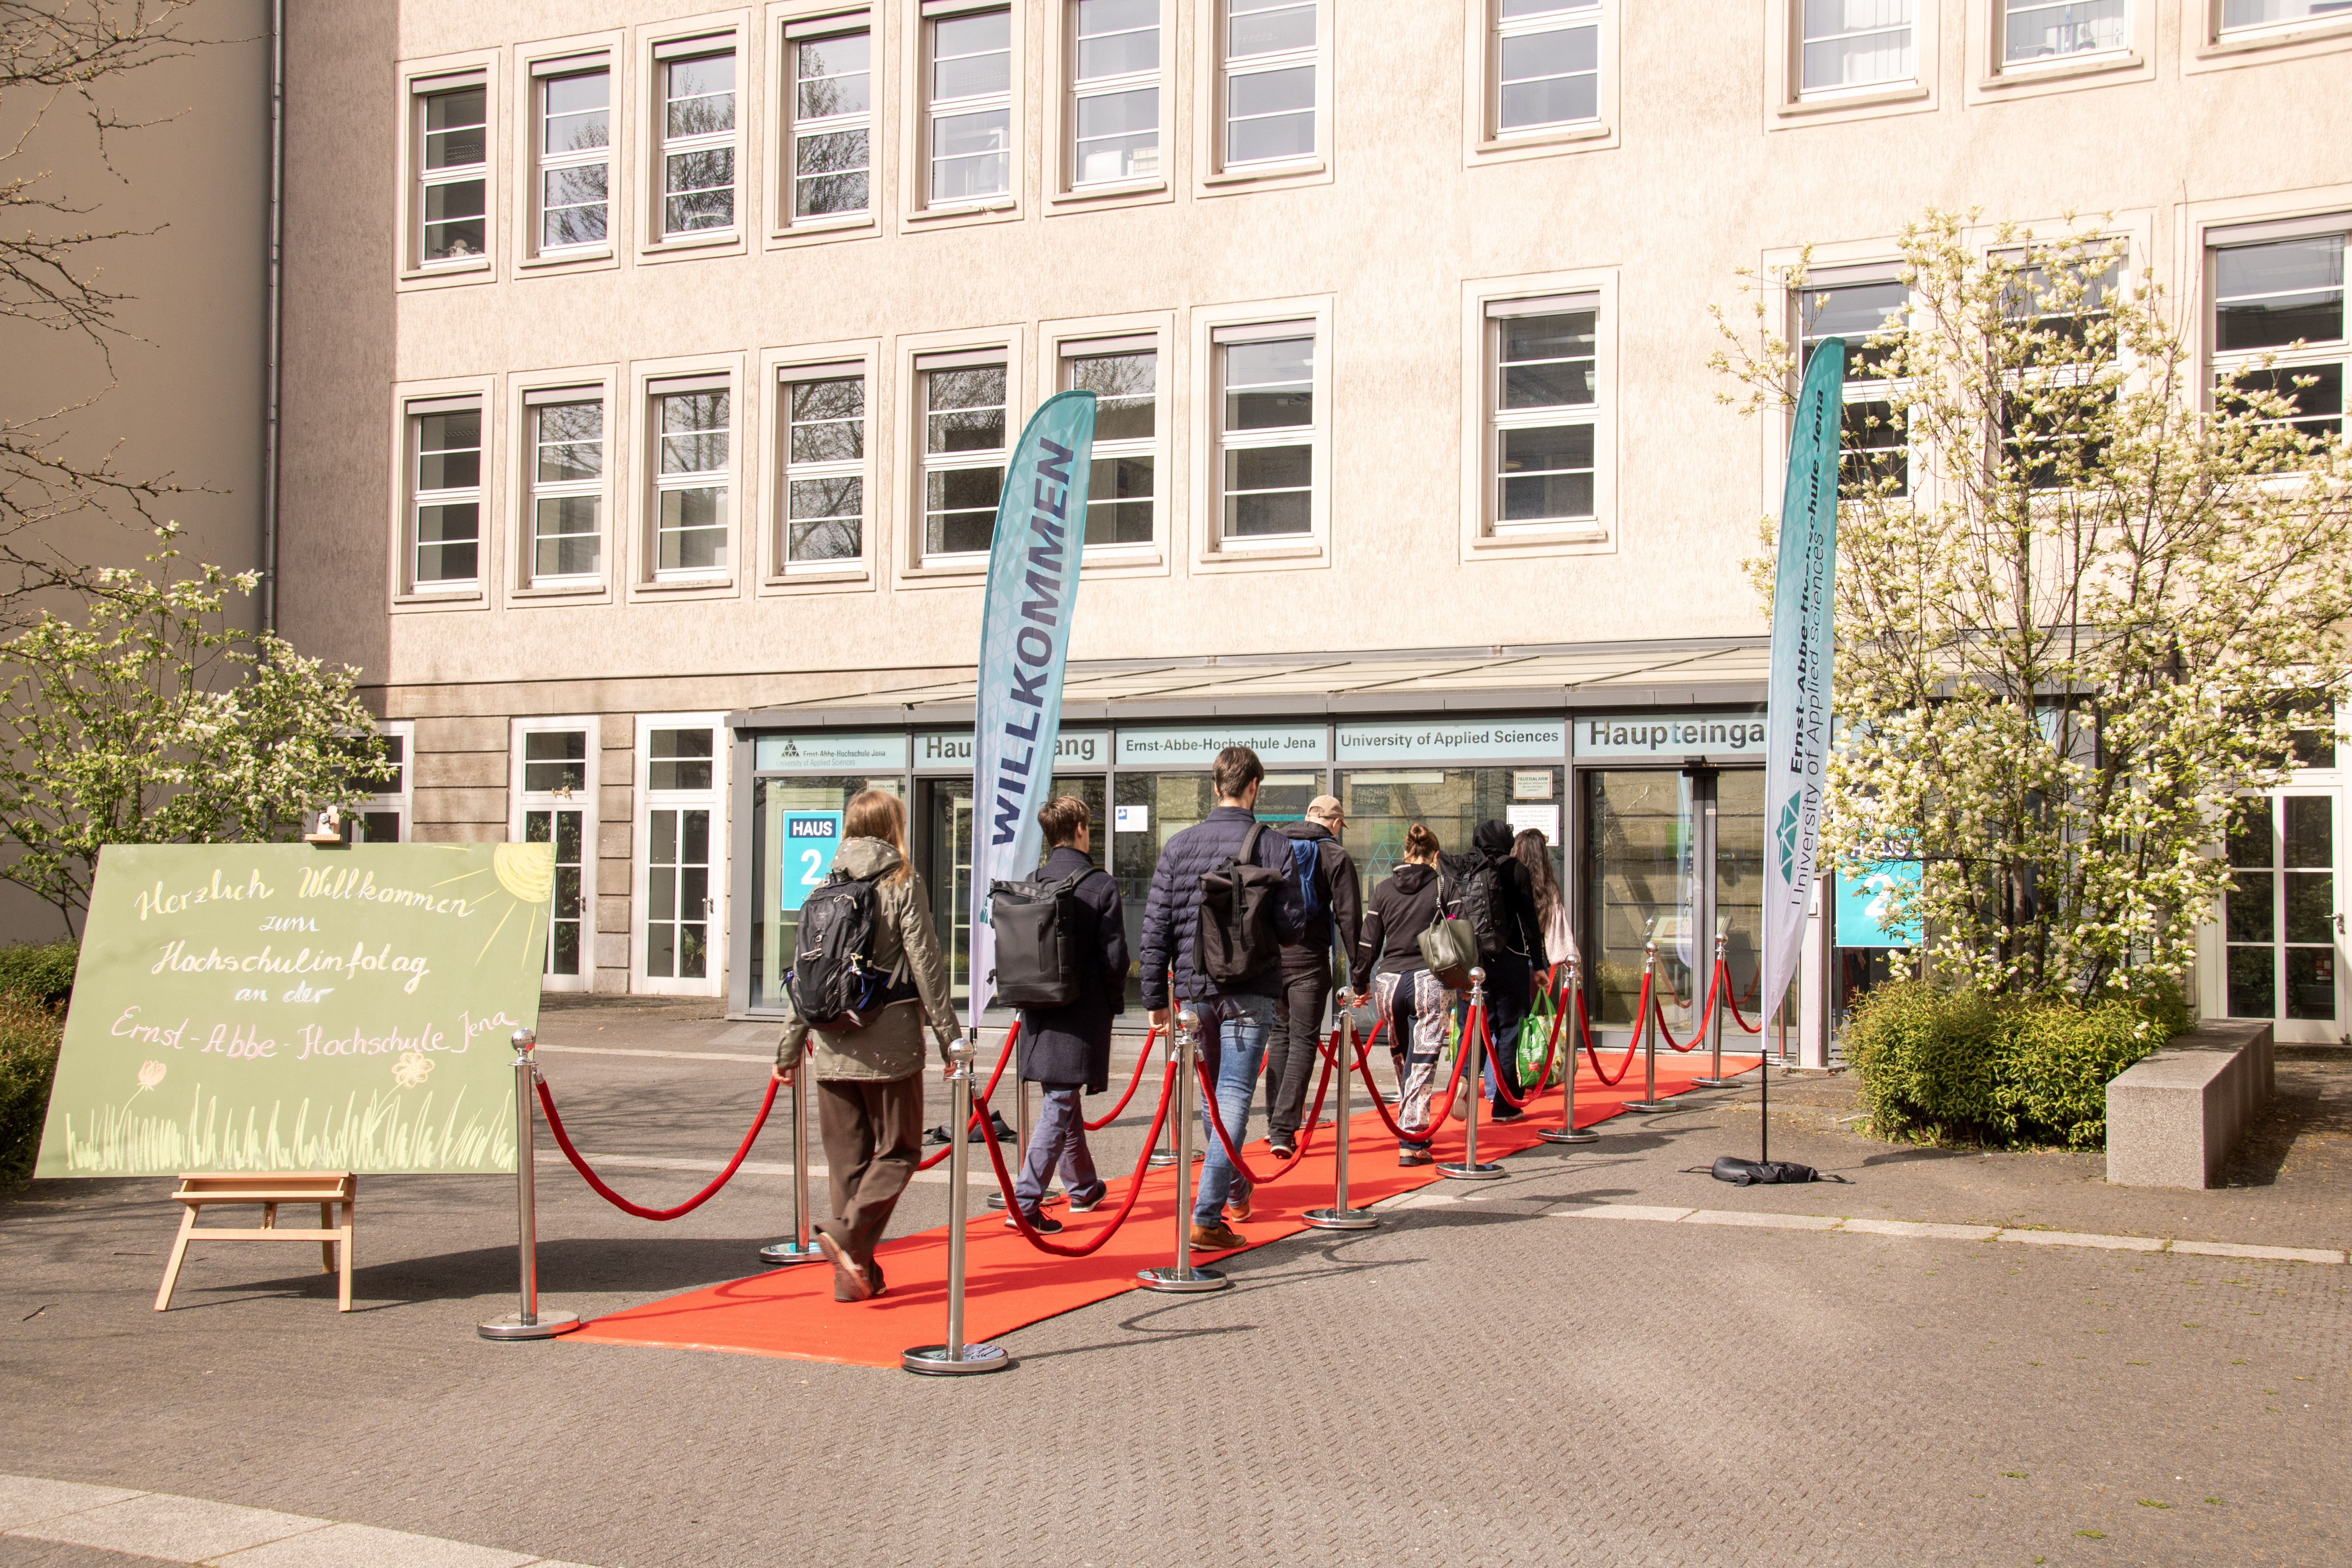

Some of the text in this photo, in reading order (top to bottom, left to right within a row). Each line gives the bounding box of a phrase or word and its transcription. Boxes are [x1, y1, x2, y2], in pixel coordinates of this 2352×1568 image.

[1813, 389, 1824, 453] Jena
[992, 436, 1075, 846] WILLKOMMEN
[1591, 718, 1765, 751] Haupteinga
[1791, 532, 1824, 904] University of Applied Sciences
[1284, 737, 1316, 749] Jena
[1341, 730, 1559, 748] University of Applied Sciences
[810, 759, 831, 767] Applied
[793, 821, 832, 836] HAUS
[801, 849, 822, 885] 2
[134, 866, 475, 921] Herzlich Willkommen
[1864, 872, 1893, 917] 2
[259, 916, 320, 932] zum
[151, 940, 430, 995] Hochschulinfotag
[234, 979, 336, 1004] an der
[450, 1010, 520, 1054] Jena
